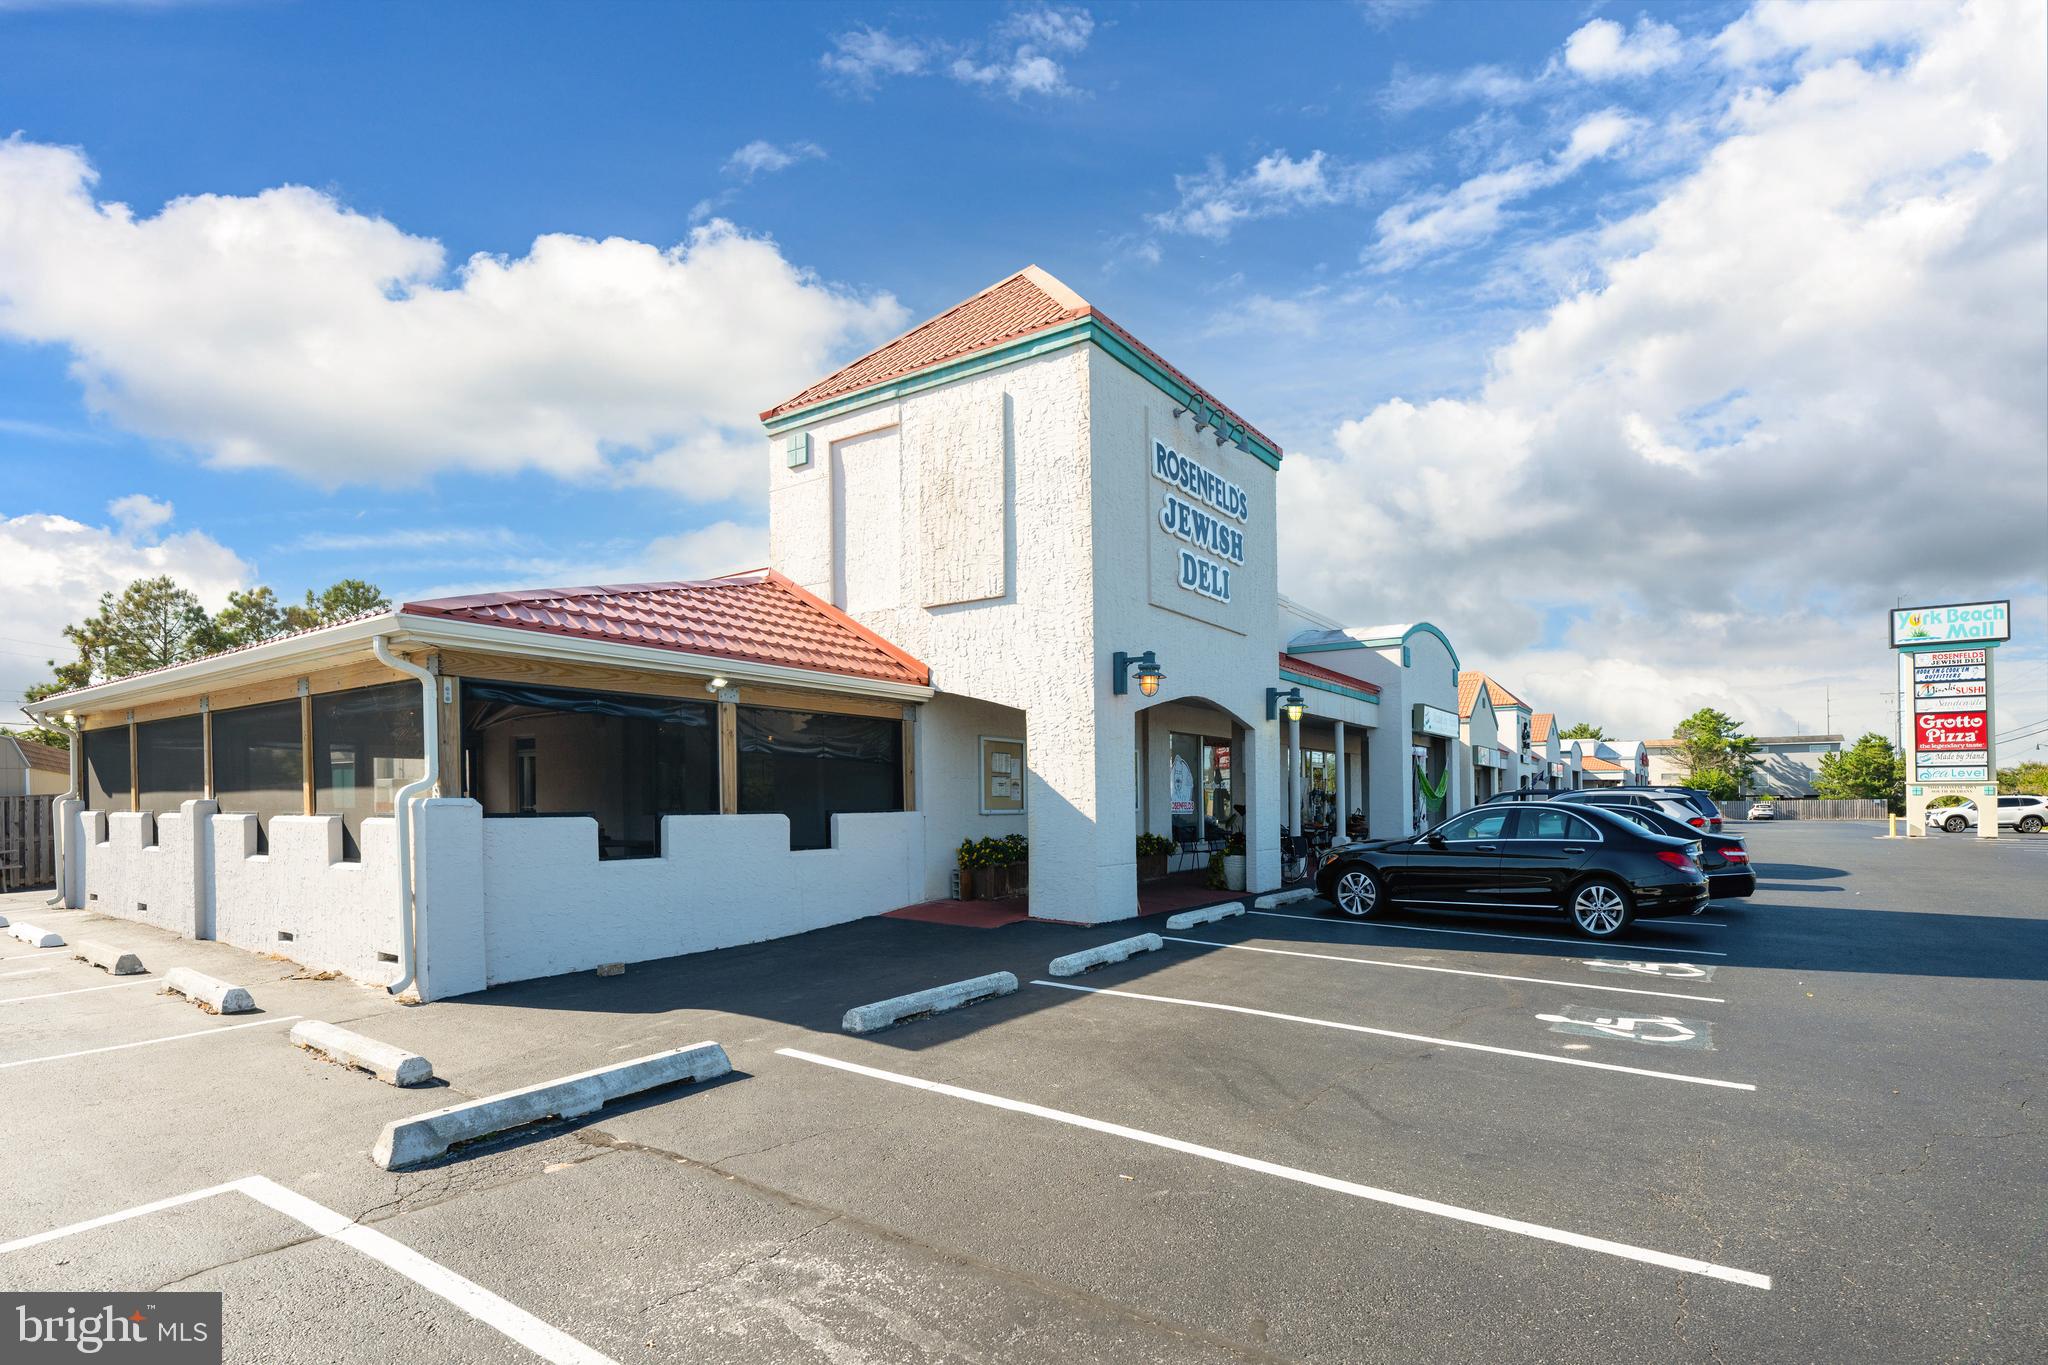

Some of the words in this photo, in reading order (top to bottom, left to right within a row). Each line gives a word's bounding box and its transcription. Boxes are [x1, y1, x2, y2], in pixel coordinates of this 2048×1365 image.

[1155, 441, 1248, 521] ROSENFELD'S
[1164, 497, 1244, 562] JEWISH
[1182, 552, 1230, 600] DELI
[1897, 610, 1942, 629] York
[1946, 605, 2005, 623] Beach
[1946, 622, 1995, 639] Mall
[1956, 685, 1984, 694] SUSHI
[1919, 714, 1983, 729] Grotto
[1925, 728, 1976, 743] Pizza
[1955, 753, 1964, 761] by
[1965, 752, 1985, 760] Hand
[1919, 767, 1949, 780] Sea
[1951, 768, 1985, 777] Level
